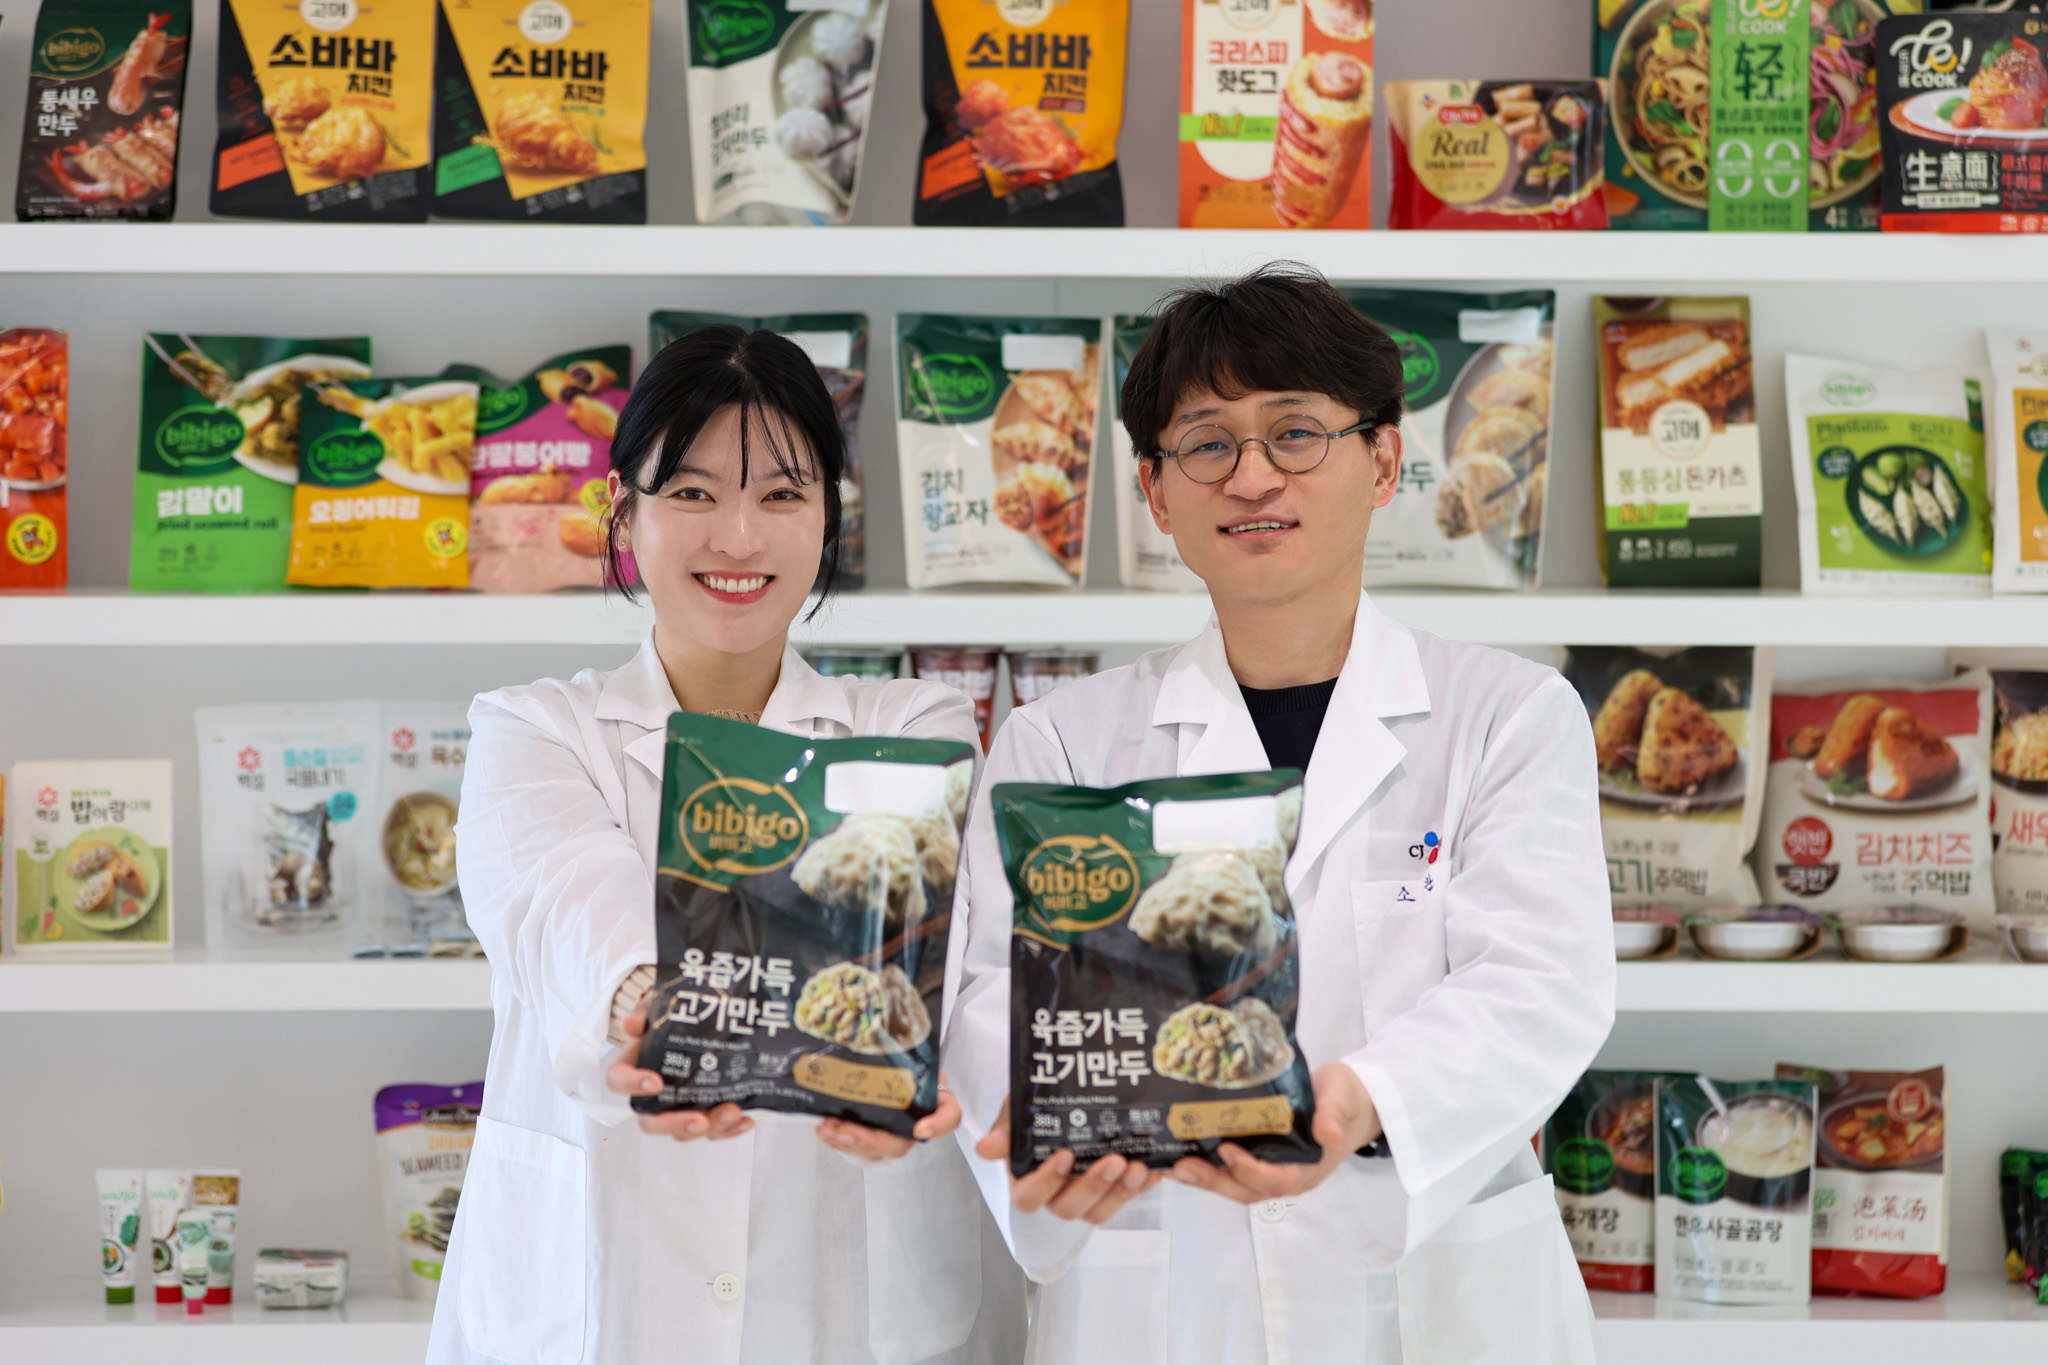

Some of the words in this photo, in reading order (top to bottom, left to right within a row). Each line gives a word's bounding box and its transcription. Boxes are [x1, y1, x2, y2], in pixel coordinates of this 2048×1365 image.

[1740, 19, 1787, 35] COOK
[267, 34, 398, 73] 소바바
[490, 47, 610, 81] 소바바
[966, 32, 1092, 71] 소바바
[1207, 40, 1288, 64] 크리스피
[347, 73, 392, 97] 치킨
[1043, 73, 1087, 96] 치킨
[1217, 69, 1278, 94] 핫도그
[1734, 41, 1784, 101] 轻
[1911, 72, 1958, 88] COOK
[39, 86, 99, 113] 통새우
[564, 82, 605, 104] 치킨
[38, 113, 78, 137] 만두
[1430, 129, 1489, 157] Real
[165, 420, 241, 447] bibigo
[1661, 419, 1700, 442] 고메
[922, 467, 963, 499] 김치
[157, 485, 243, 518] 김말이
[924, 499, 988, 531] 왕교자
[692, 801, 799, 848] bibigo
[1408, 845, 1425, 860] CJ
[1787, 827, 1828, 857] 햇반
[1855, 831, 1974, 867] 김치치즈
[1027, 859, 1131, 902] bibigo
[1655, 867, 1710, 897] 주먹밥
[1902, 869, 1971, 897] 주먹밥
[679, 948, 796, 997] 육즙가득
[668, 990, 791, 1037] 고기만두
[1031, 1007, 1149, 1047] 육즙가득
[1030, 1050, 1151, 1087] 고기만두
[1853, 1195, 1928, 1222] 泡菜汤
